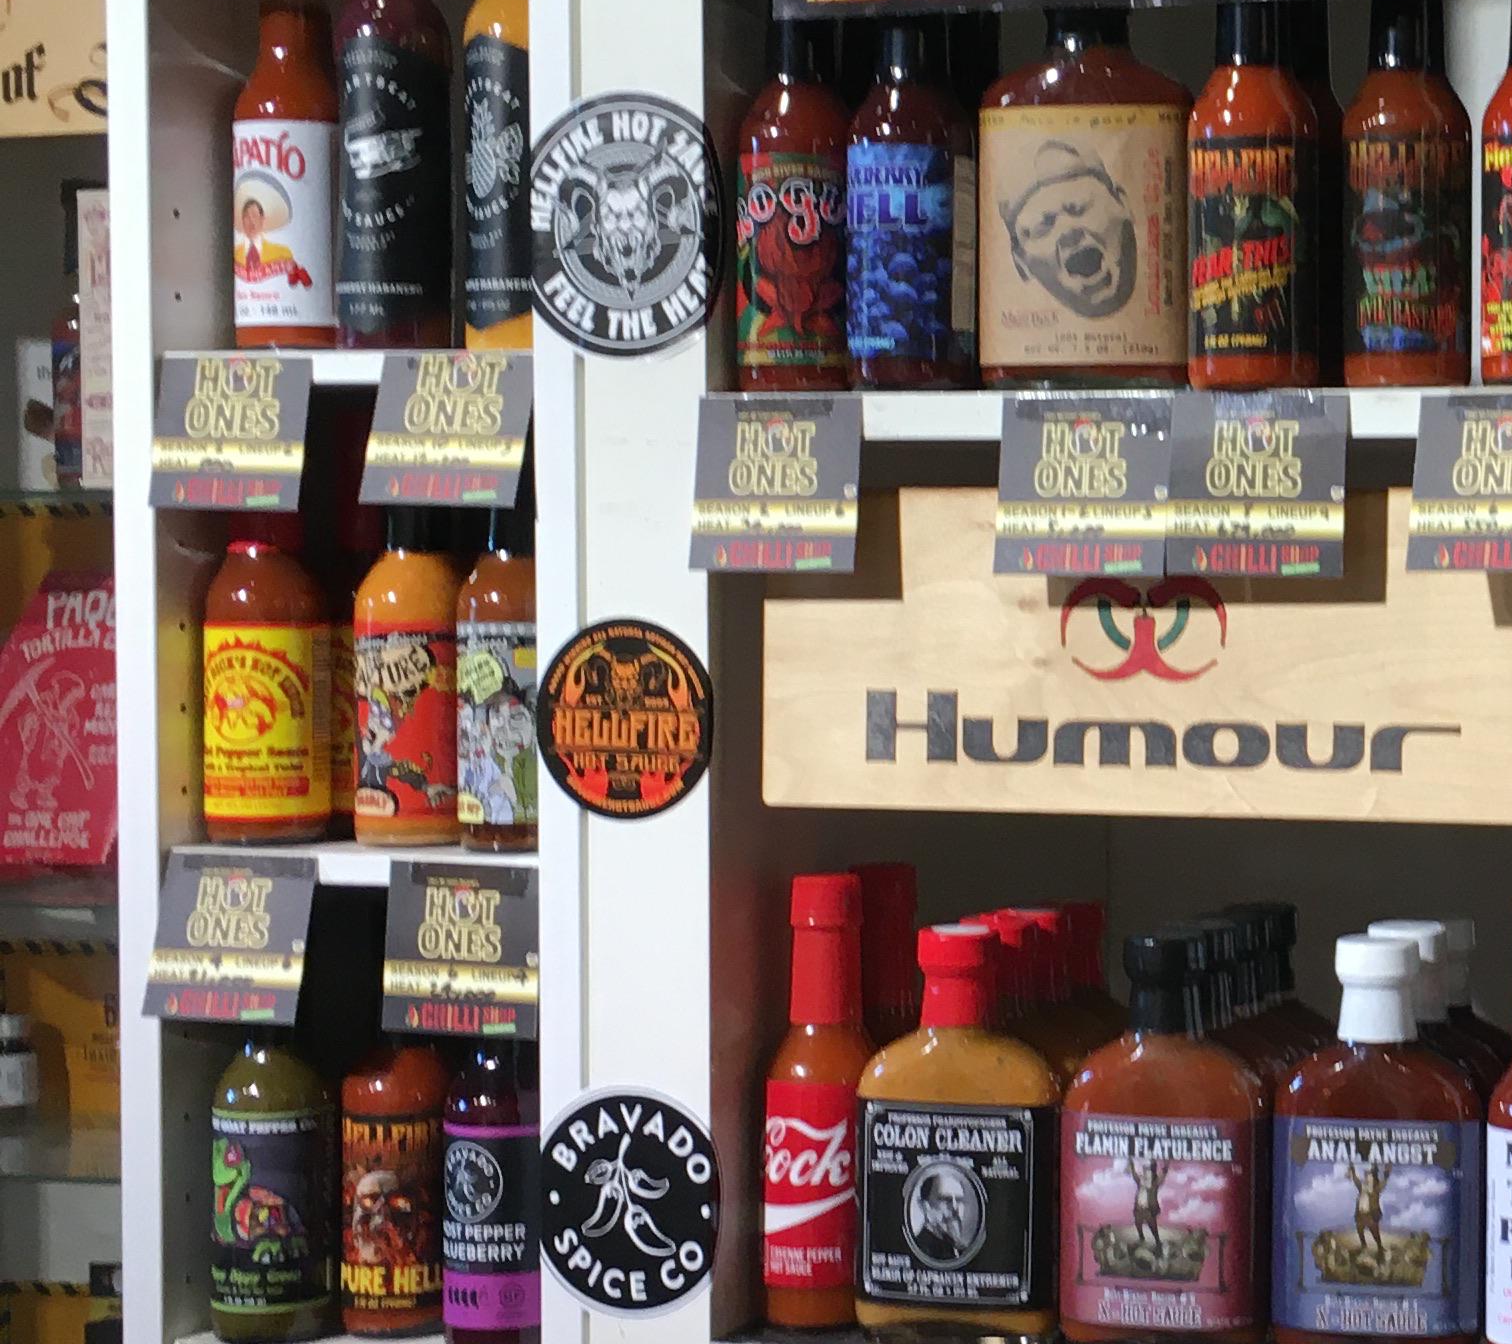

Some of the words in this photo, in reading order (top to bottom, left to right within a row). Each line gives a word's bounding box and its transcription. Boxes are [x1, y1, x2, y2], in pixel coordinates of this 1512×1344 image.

[611, 108, 665, 142] HOT
[542, 277, 594, 332] FEEL
[606, 305, 656, 341] THE
[194, 359, 280, 401] HOT
[416, 356, 507, 399] HOT
[185, 398, 280, 440] ONES
[404, 395, 503, 438] ONES
[737, 420, 815, 460] HOT
[1043, 420, 1124, 460] HOT
[1214, 420, 1291, 460] HOT
[730, 460, 817, 497] ONES
[1035, 460, 1126, 497] ONES
[1207, 460, 1294, 497] ONES
[554, 711, 698, 751] HELLFIRE
[865, 688, 1462, 775] Humour
[196, 876, 272, 916] HOT
[425, 887, 502, 926] HOT
[186, 914, 270, 950] ONES
[418, 926, 502, 962] ONES
[549, 1102, 711, 1184] BRAVADO
[873, 1125, 929, 1149] COLON
[935, 1126, 1023, 1153] CLEANER
[1075, 1132, 1126, 1156] FLAMIN
[1135, 1137, 1233, 1162] FLATULENCE
[1306, 1141, 1362, 1163] ANAL
[1369, 1144, 1438, 1164] ANGST
[342, 1266, 384, 1295] PURE
[551, 1227, 648, 1302] SPICE
[660, 1240, 705, 1288] CO
